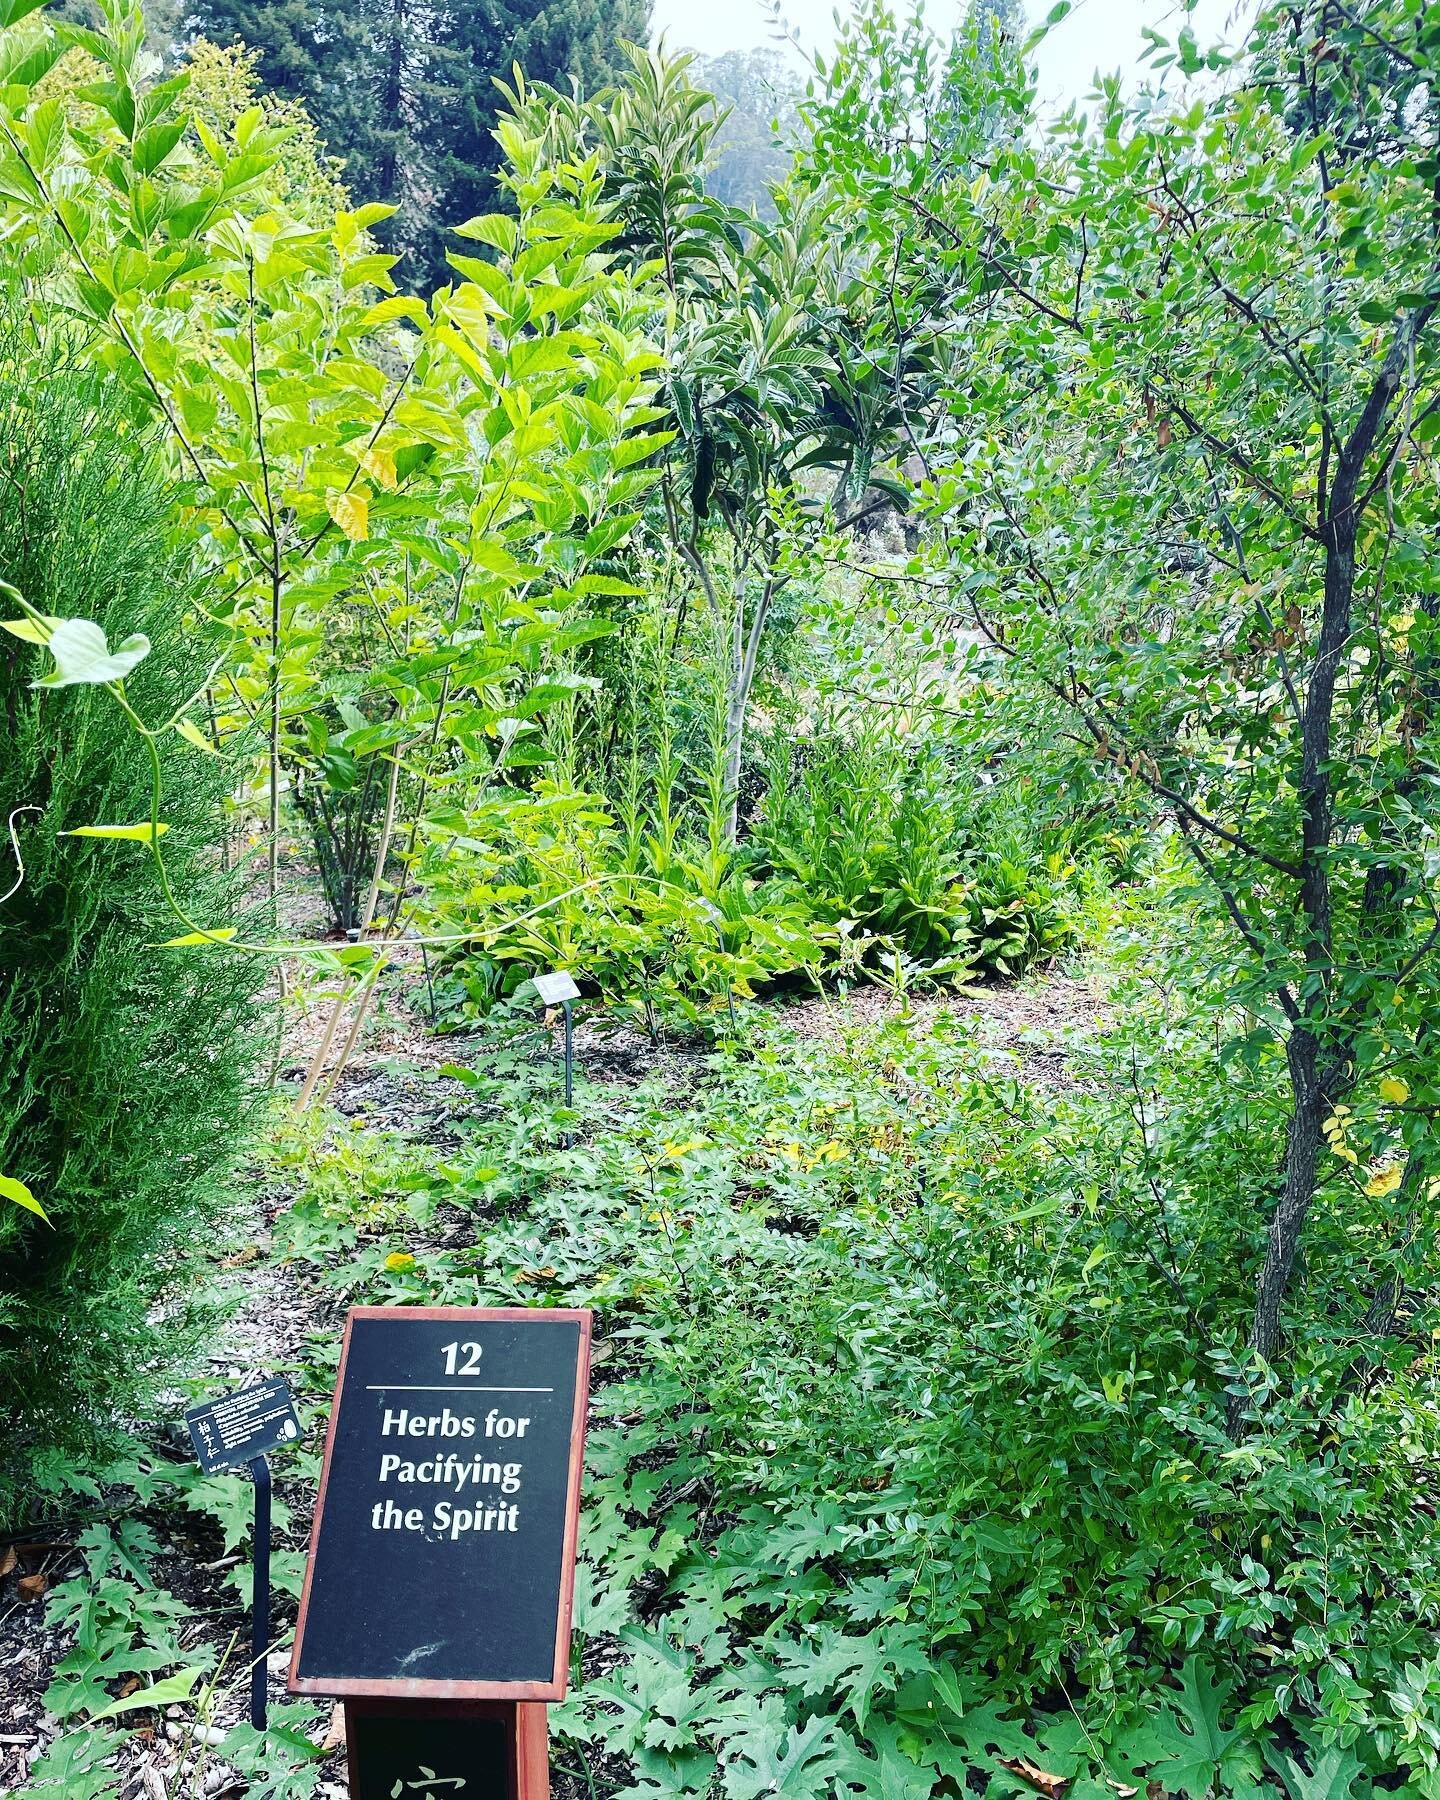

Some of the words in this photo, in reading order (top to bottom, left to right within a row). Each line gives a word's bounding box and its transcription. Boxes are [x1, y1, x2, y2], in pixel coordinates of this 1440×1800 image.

[440, 1341, 483, 1376] 12
[381, 1408, 476, 1438] Herbs
[484, 1408, 531, 1438] for
[378, 1452, 523, 1494] Pacifying
[371, 1499, 424, 1531] the
[432, 1500, 520, 1541] Spirit
